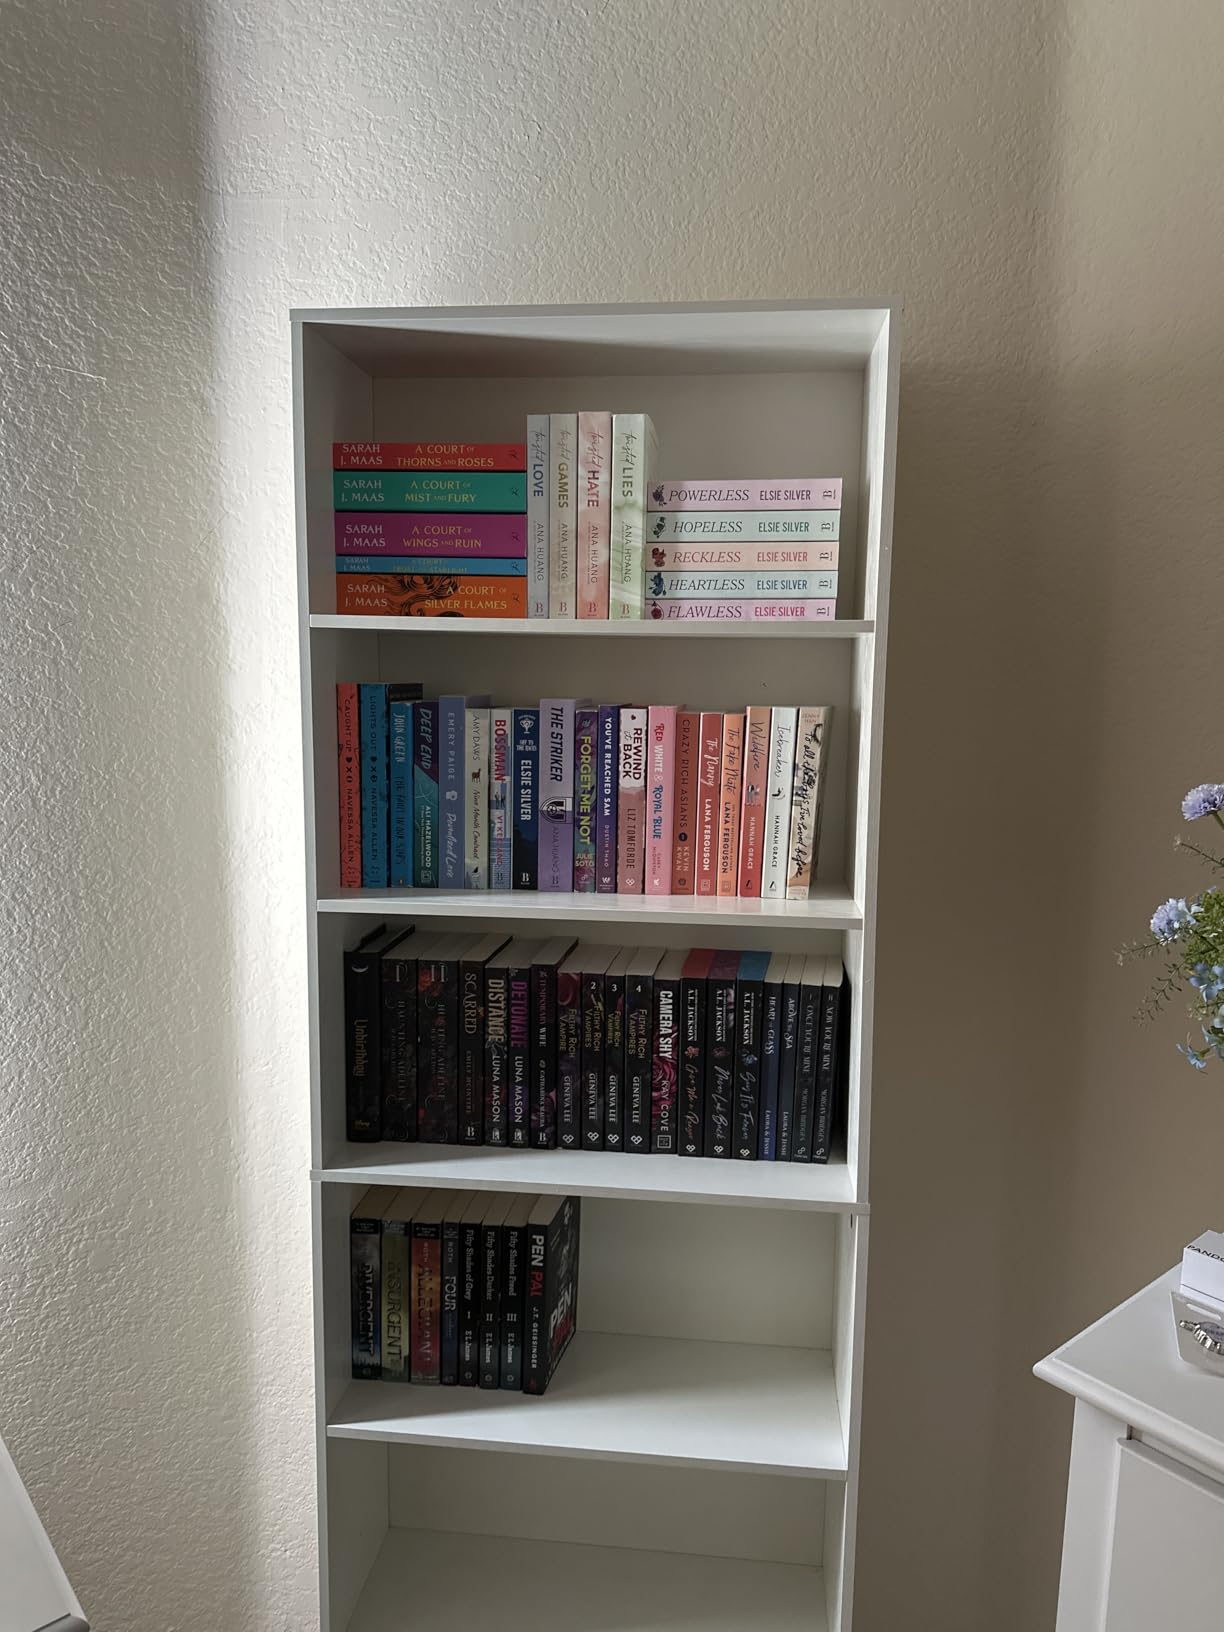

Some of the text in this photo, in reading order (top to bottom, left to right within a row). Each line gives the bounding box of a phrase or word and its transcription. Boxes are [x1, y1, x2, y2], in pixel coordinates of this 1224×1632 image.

[342, 444, 380, 453] SARAH
[350, 455, 383, 465] MAAS
[397, 457, 494, 467] THORNS ROSES
[427, 445, 464, 454] COURT
[343, 479, 382, 489] SARAH
[351, 492, 384, 502] MAAS
[422, 480, 460, 490] COURT
[533, 463, 544, 497] LOVE
[558, 462, 569, 508] GAMES
[587, 470, 599, 507] HATE
[622, 467, 633, 497] LIES
[668, 489, 750, 502] POWERLESS
[760, 490, 811, 501] ELSIE SILVER
[404, 493, 477, 503] MIST FURY
[345, 524, 383, 534] SARAH
[353, 537, 386, 547] MAAS
[402, 538, 482, 548] WINGS RUIN
[423, 525, 462, 535] COURT
[673, 521, 743, 533] HOPELESS
[758, 521, 809, 533] ELSIE SILVER
[536, 523, 544, 581] ANA HUANG
[590, 525, 598, 583] ANA HUANG
[624, 524, 632, 583] ANA HUANG
[673, 551, 741, 563] RECKLESS
[757, 551, 808, 562] ELSIE SILVER
[347, 584, 385, 593] SARAH
[355, 597, 388, 607] MAAS
[458, 586, 495, 595] COURT
[669, 578, 745, 591] HEARTLESS
[756, 579, 807, 590] ELSIE SILVER
[424, 599, 507, 610] SILVER FLAMES
[667, 605, 742, 618] FLAWLESS
[754, 606, 805, 617] ELSIE SILVER
[393, 713, 407, 763] JOHN GREEN
[420, 708, 432, 769] DEEP END
[447, 712, 456, 780] EMERY PAIGE
[472, 715, 480, 761] AMY DAWS
[495, 719, 506, 781] BOSSMAN
[550, 707, 563, 782] THE STRIKER
[633, 727, 642, 780] REWIND
[750, 721, 766, 771] Wildfire
[774, 726, 791, 778] Icebreaker
[520, 759, 532, 785] ELSIE
[603, 717, 612, 816] YOU'VE REACHED SAM
[622, 744, 632, 779] BACK
[680, 719, 690, 828] CRAZY RICH ASIANS
[701, 738, 719, 787] The Nanny
[724, 727, 740, 793] The Mate
[520, 788, 532, 821] SILVER
[579, 735, 592, 845] FORGET ME NOT
[792, 745, 815, 878] all loved before
[626, 808, 636, 869] LIZ TOMFORDE
[703, 798, 712, 871] LANA FERGUSON
[722, 827, 730, 874] FERGUSON
[682, 846, 690, 872] KEVIN
[463, 972, 477, 1034] SCARRED
[590, 981, 597, 990] 2
[611, 983, 618, 992] 3
[635, 984, 642, 993] 4
[488, 979, 505, 1042] DISTANCE
[511, 981, 528, 1047] DETONATE
[659, 990, 673, 1059] CAMERA SHY
[687, 1005, 695, 1041] JACKSON
[353, 1018, 368, 1076] Unbirthday
[764, 1029, 775, 1054] GLASS
[784, 1032, 793, 1049] SEA
[492, 1054, 501, 1122] LUNA MASON
[514, 1056, 523, 1123] LUNA MASON
[563, 1075, 571, 1123] GENEVA LEE
[588, 1073, 596, 1120] GENEVA LEE
[632, 1076, 640, 1123] GENEVA LEE
[661, 1080, 669, 1132] KAY COVE
[465, 1229, 474, 1247] Fifty
[465, 1248, 474, 1273] Shades
[486, 1231, 495, 1300] Fifty Shades Darker
[509, 1231, 518, 1296] Fifty Shades Freed
[529, 1234, 544, 1297] PEN PAL
[444, 1275, 457, 1310] FOUR
[464, 1282, 473, 1300] Grey
[360, 1263, 373, 1356] DIVERGENT
[387, 1260, 402, 1359] INSURGENT
[507, 1312, 517, 1322] III
[531, 1322, 539, 1368] GEISSINGER
